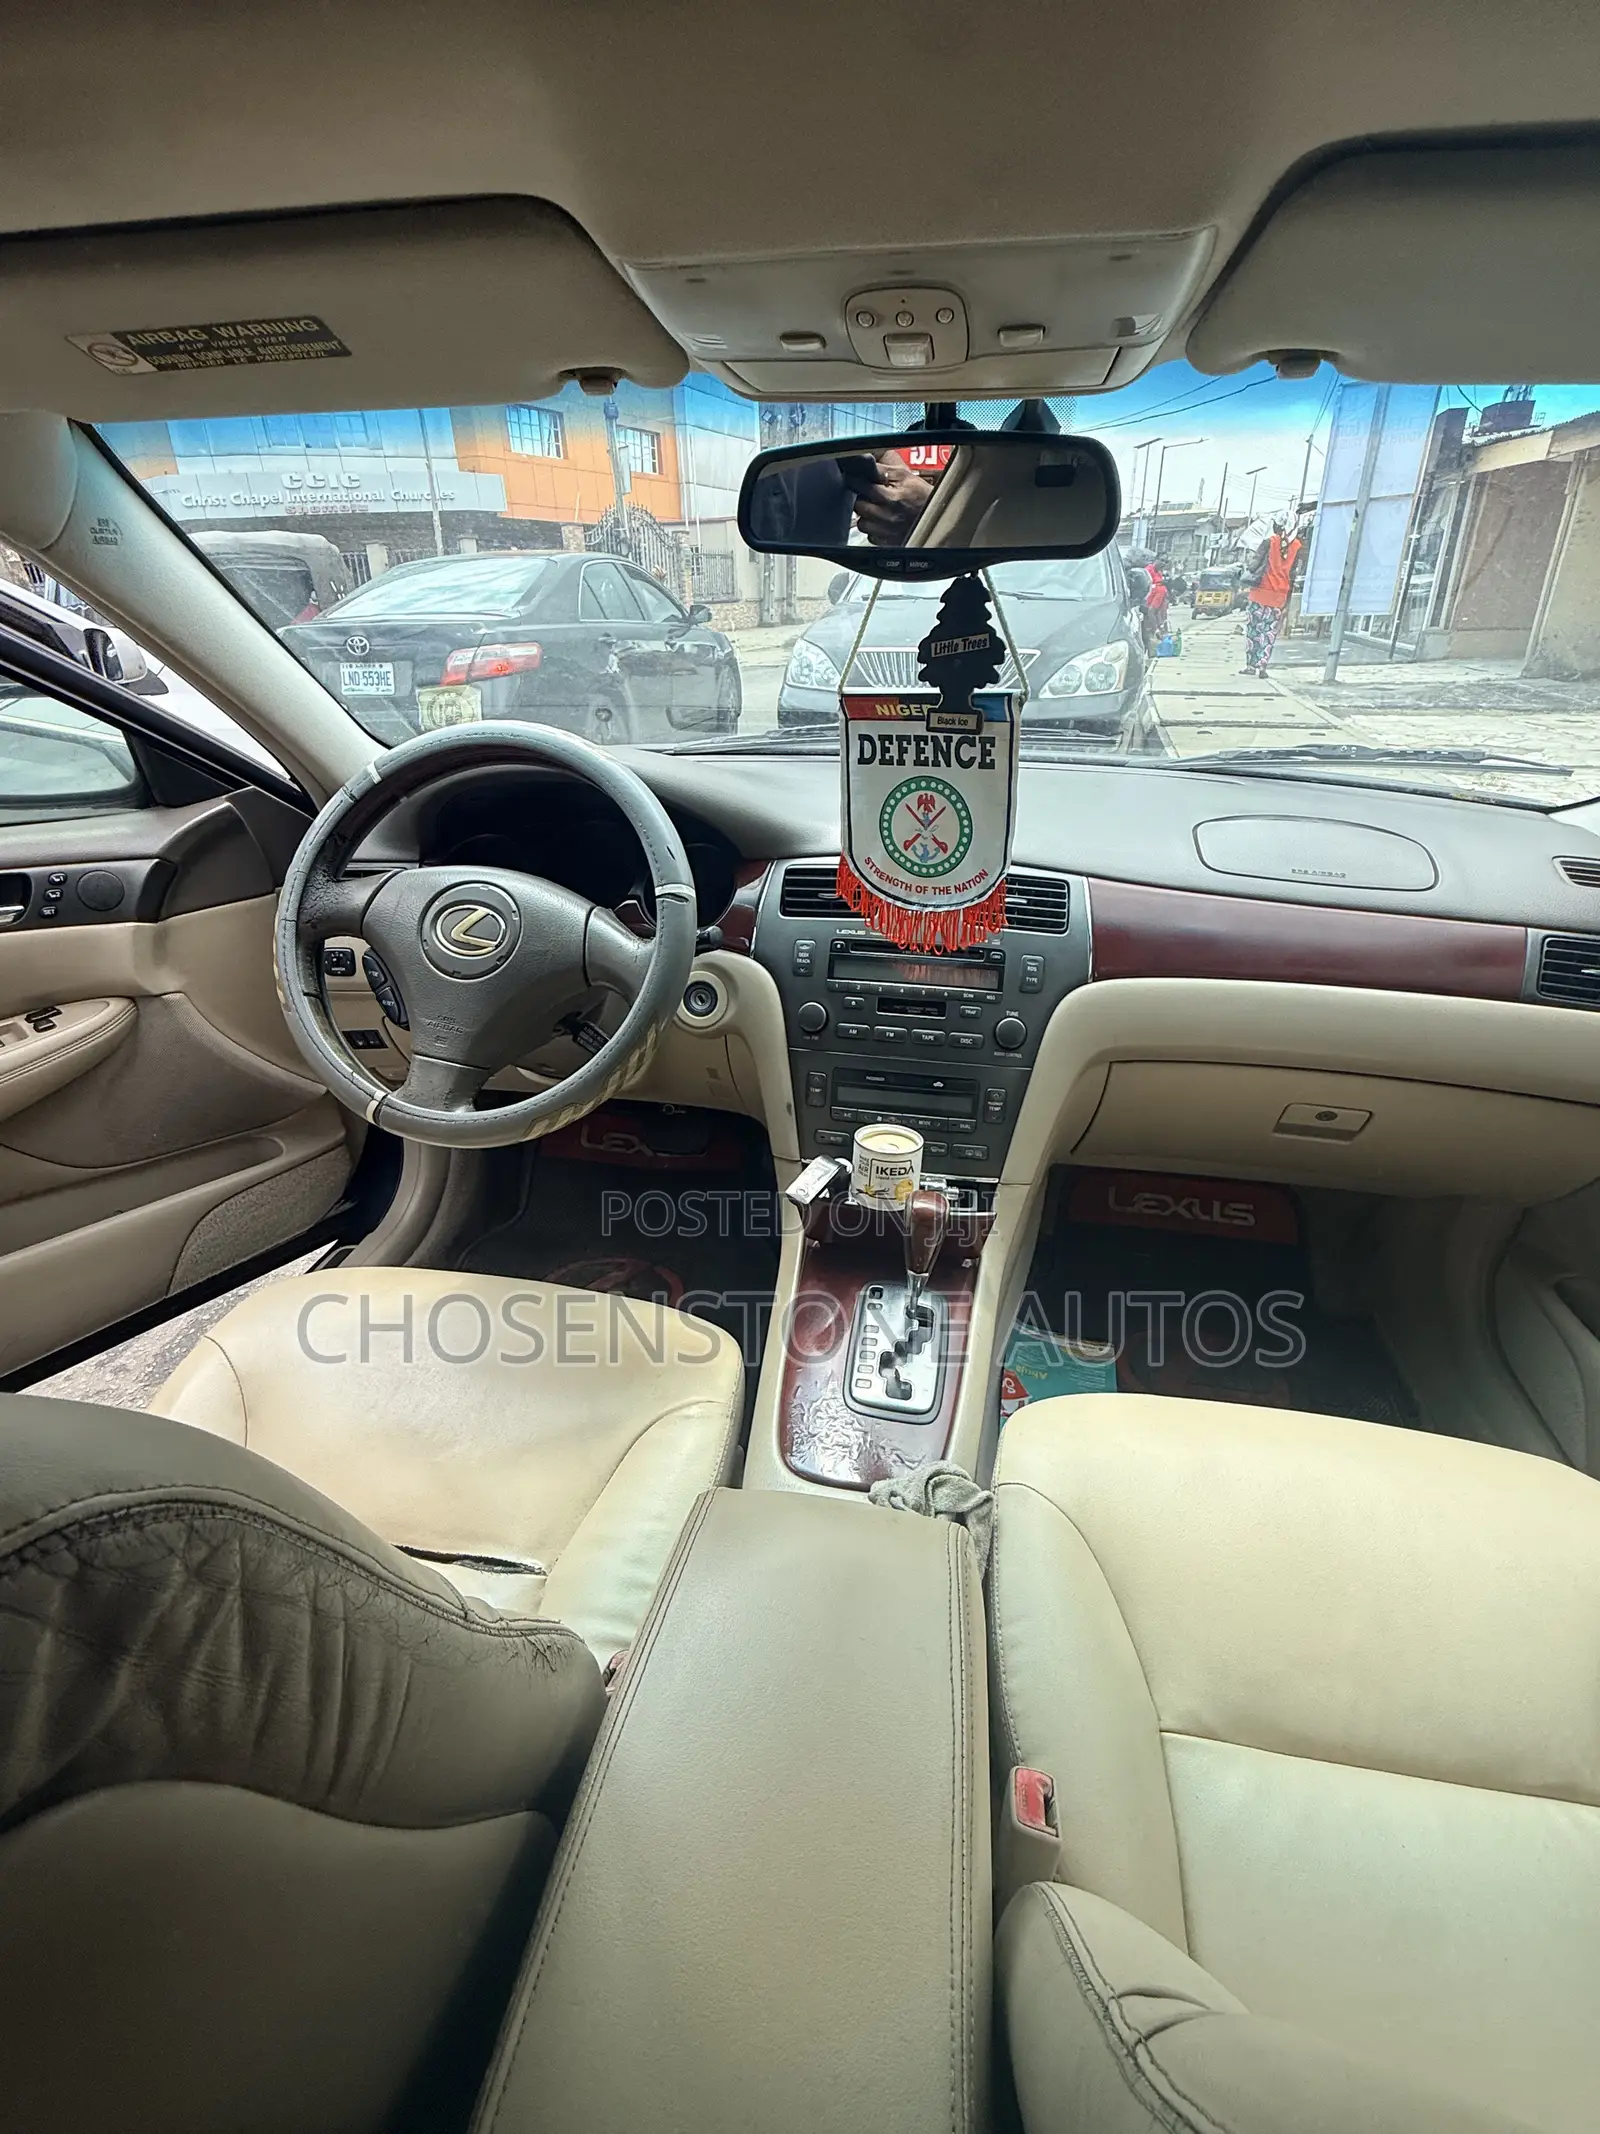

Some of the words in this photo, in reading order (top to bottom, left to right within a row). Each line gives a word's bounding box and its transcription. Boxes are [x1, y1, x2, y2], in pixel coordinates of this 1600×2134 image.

[127, 329, 209, 346] AIRBAG
[212, 319, 320, 339] WARNING
[181, 493, 227, 508] Christ
[230, 489, 284, 507] Chapel
[286, 487, 386, 504] International
[933, 641, 960, 656] Little
[961, 636, 989, 652] Trees
[936, 715, 957, 726] Black
[957, 716, 969, 727] Ice
[857, 734, 996, 770] DEFENCE
[864, 856, 913, 892] STRENGTH
[915, 885, 929, 895] OF
[932, 886, 952, 896] THE
[954, 868, 989, 893] NATION
[921, 1033, 935, 1041] TAPE
[875, 1164, 915, 1176] IKEDA
[1108, 1186, 1256, 1227] LEXUS
